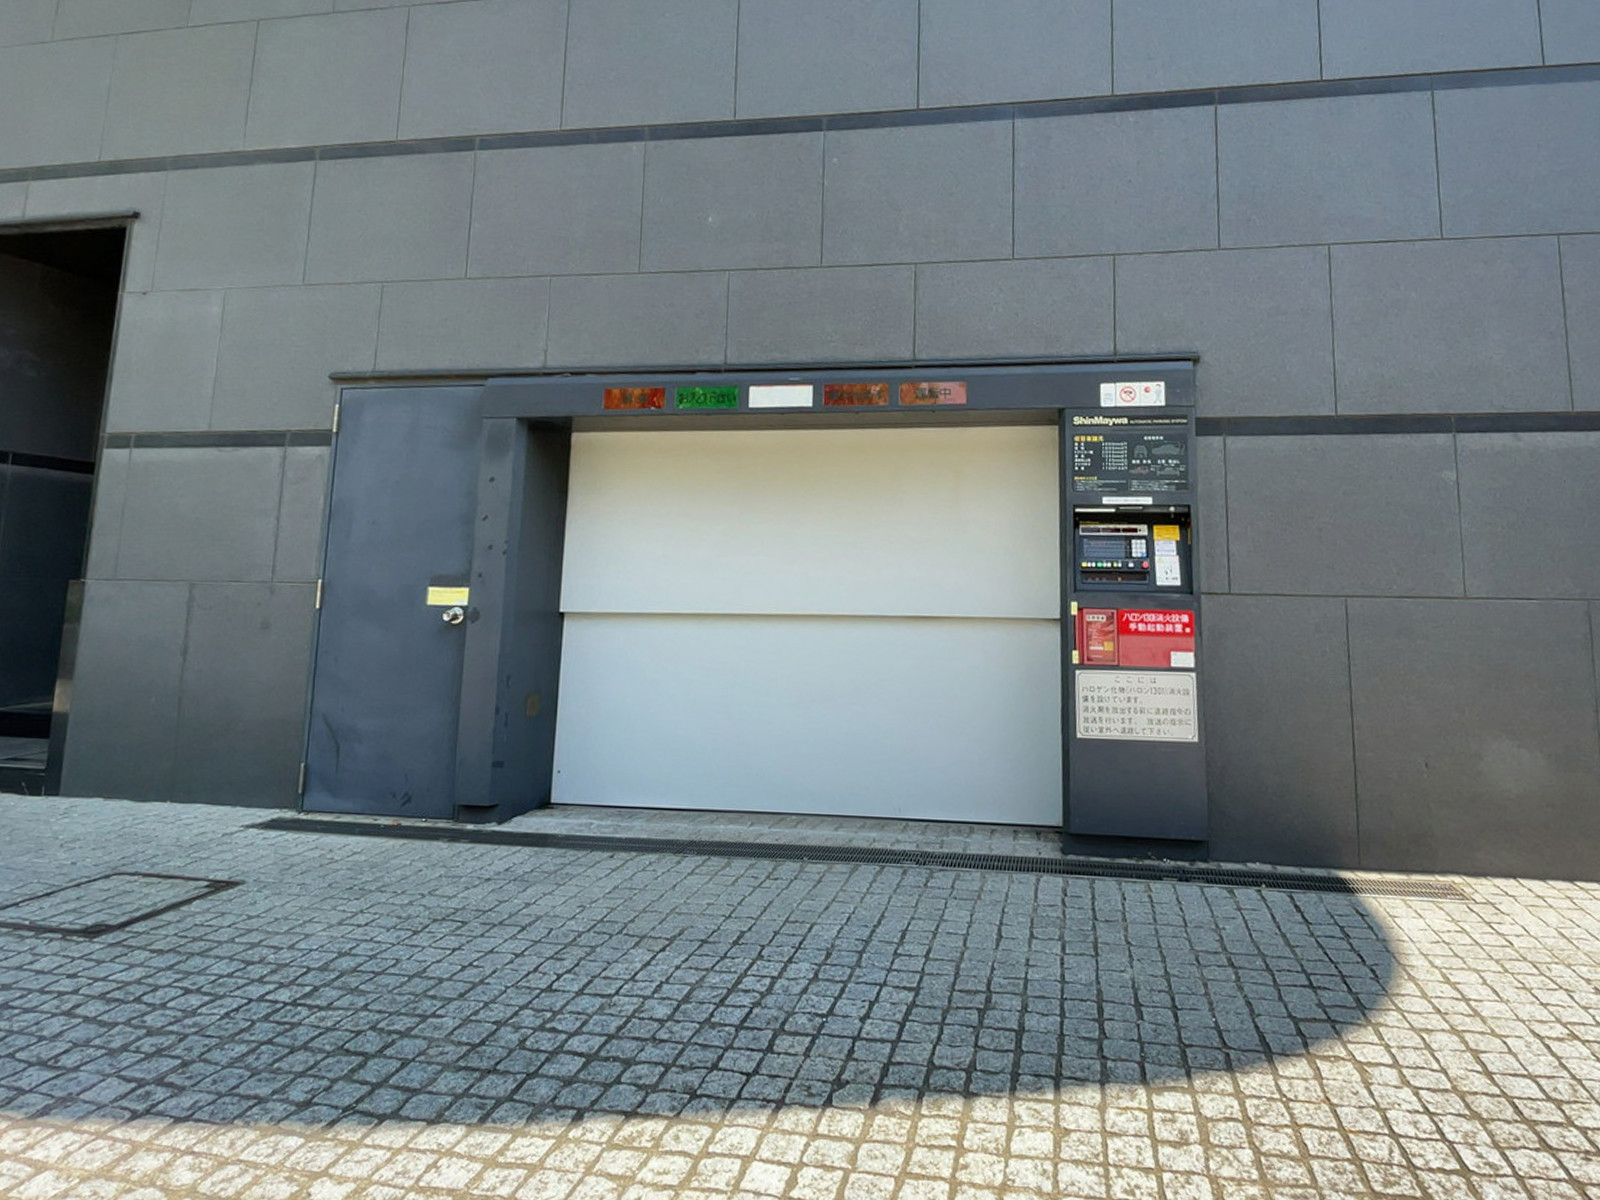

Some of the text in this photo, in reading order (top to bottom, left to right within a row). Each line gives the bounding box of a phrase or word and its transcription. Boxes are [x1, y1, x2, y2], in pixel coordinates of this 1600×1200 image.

[1073, 416, 1128, 426] ShinMaywa
[1114, 676, 1157, 684] ここには
